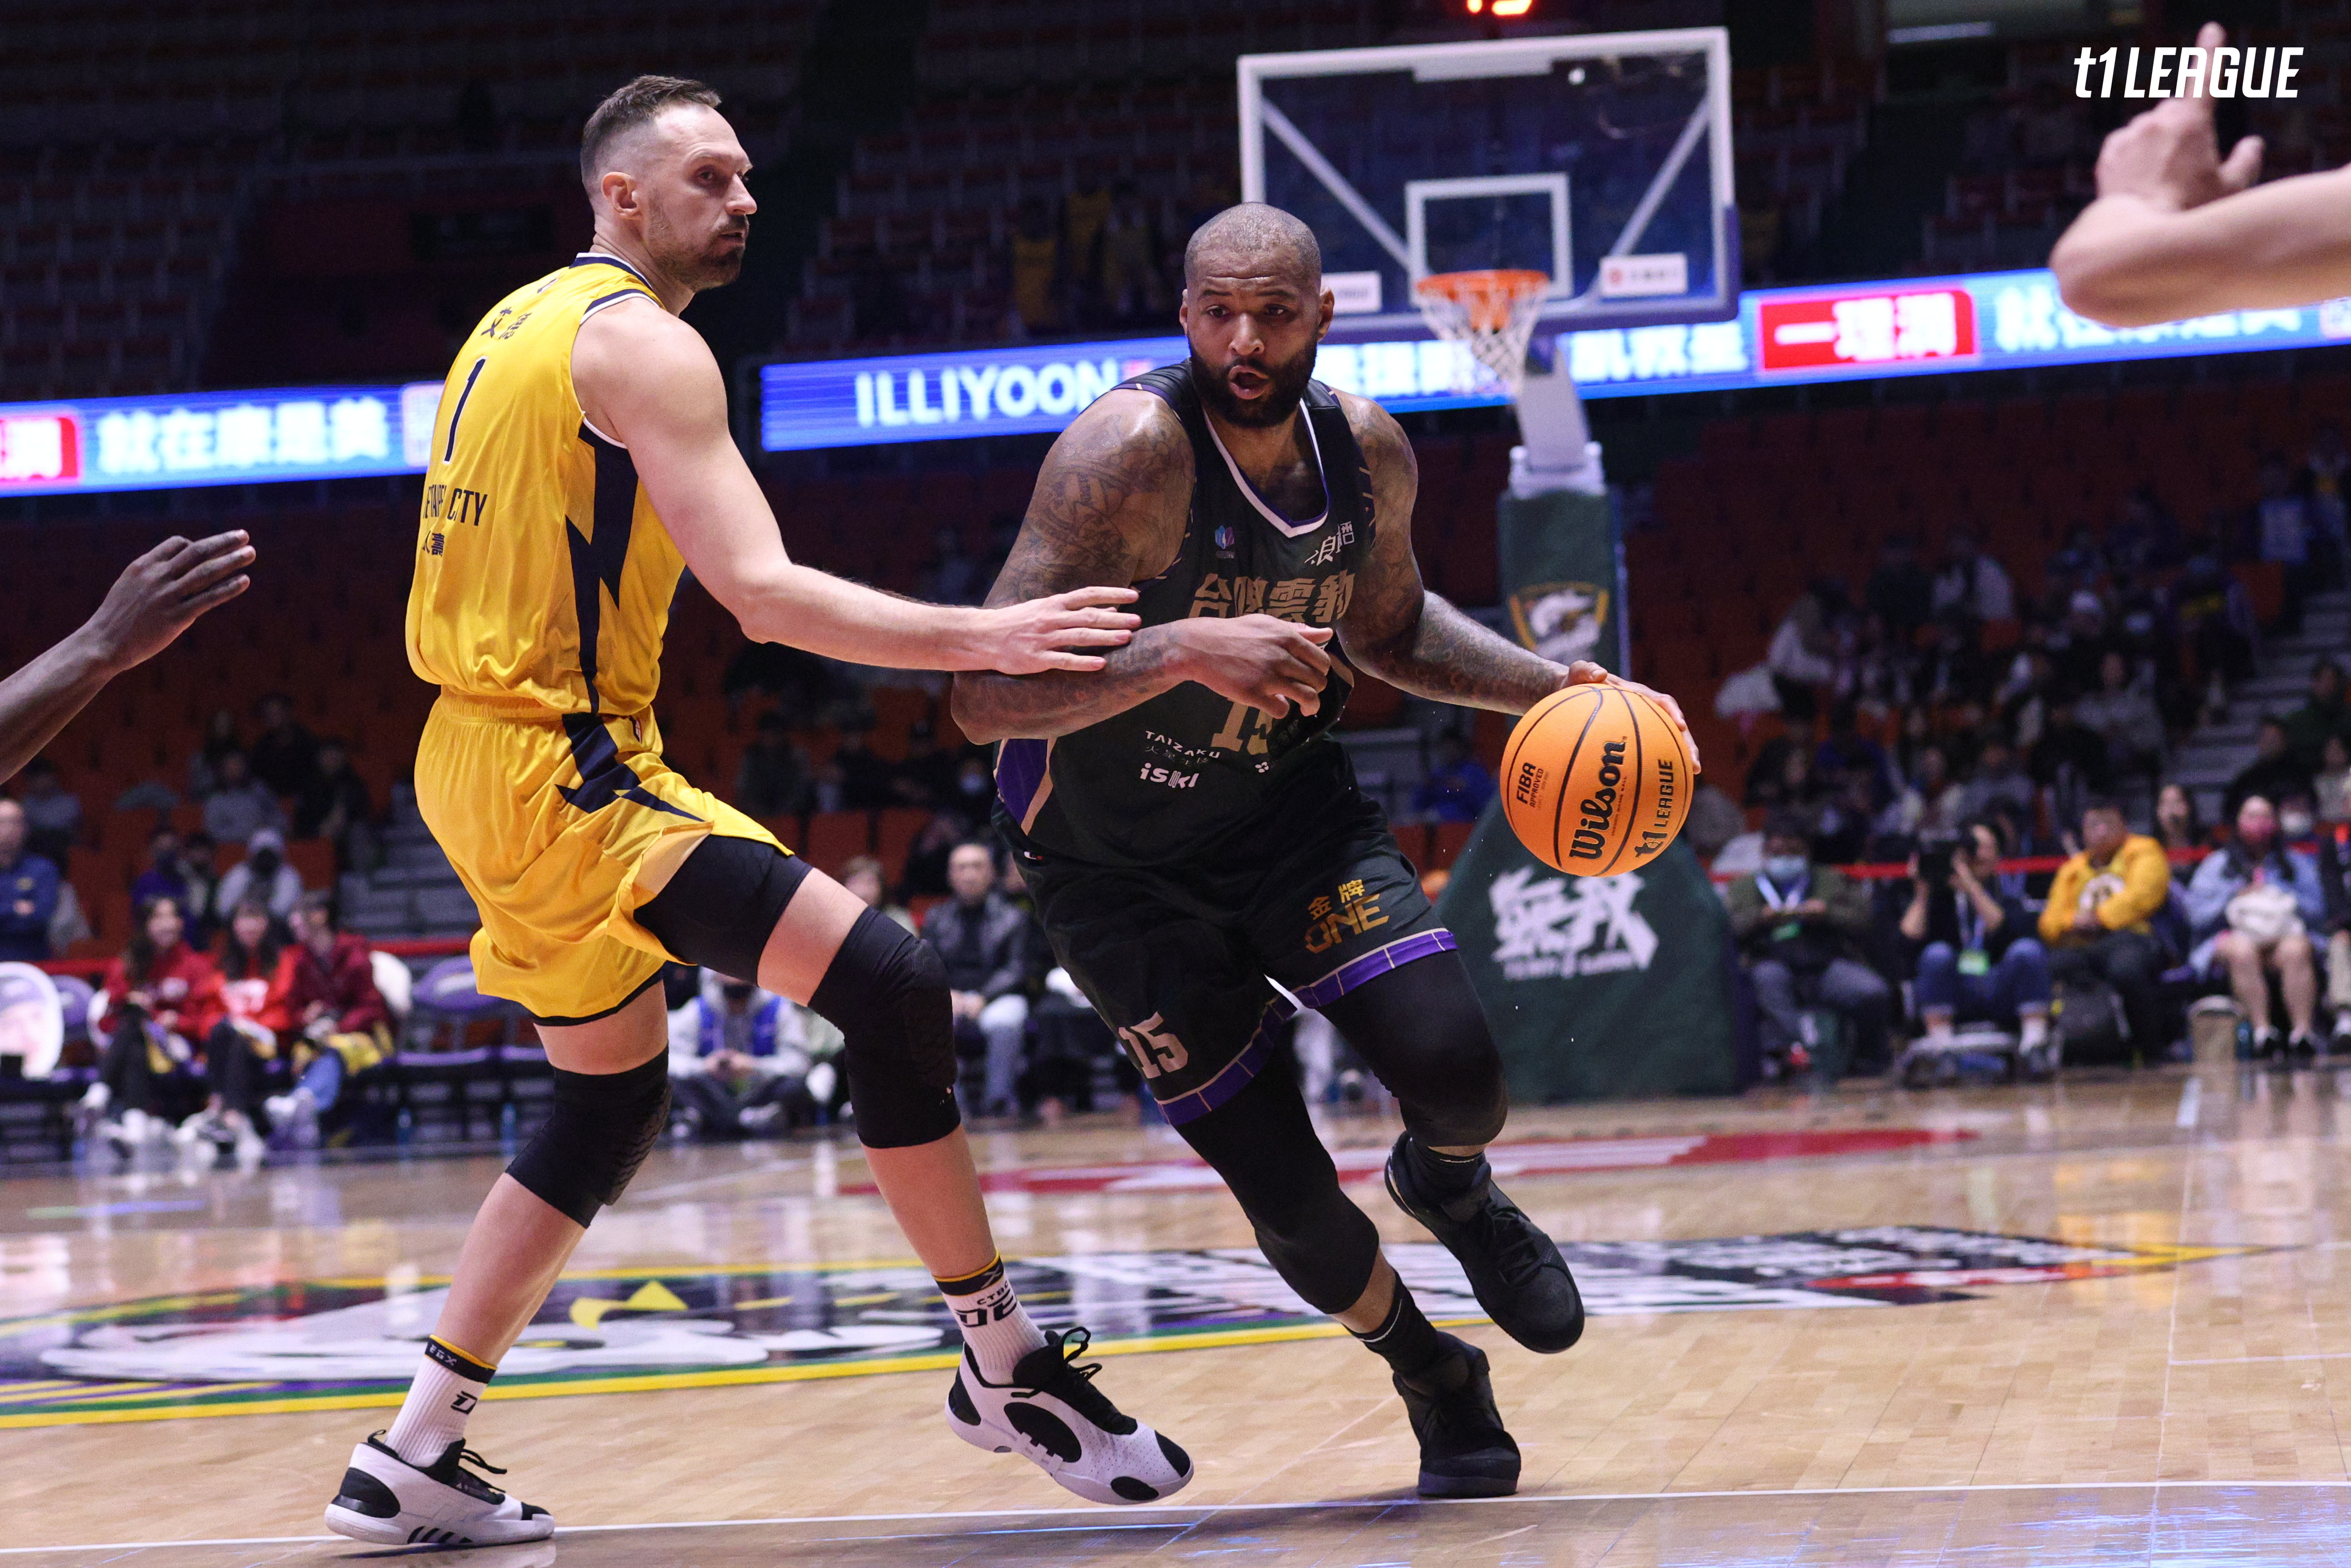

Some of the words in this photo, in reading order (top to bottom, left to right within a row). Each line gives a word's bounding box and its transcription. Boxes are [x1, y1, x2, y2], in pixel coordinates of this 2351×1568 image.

[442, 355, 488, 465] 1
[854, 358, 1117, 428] ILLIYOON
[447, 487, 488, 527] CTY
[1145, 730, 1221, 759] TAIZAKU
[1516, 762, 1537, 805] FIBA
[1529, 768, 1544, 808] APPROVED
[1569, 740, 1626, 860] Wilson
[1654, 759, 1674, 829] LEAGUE
[1304, 893, 1390, 954] ONE
[1307, 878, 1365, 921] 金牌
[1118, 1011, 1189, 1079] 15
[977, 1280, 1009, 1305] CTBC
